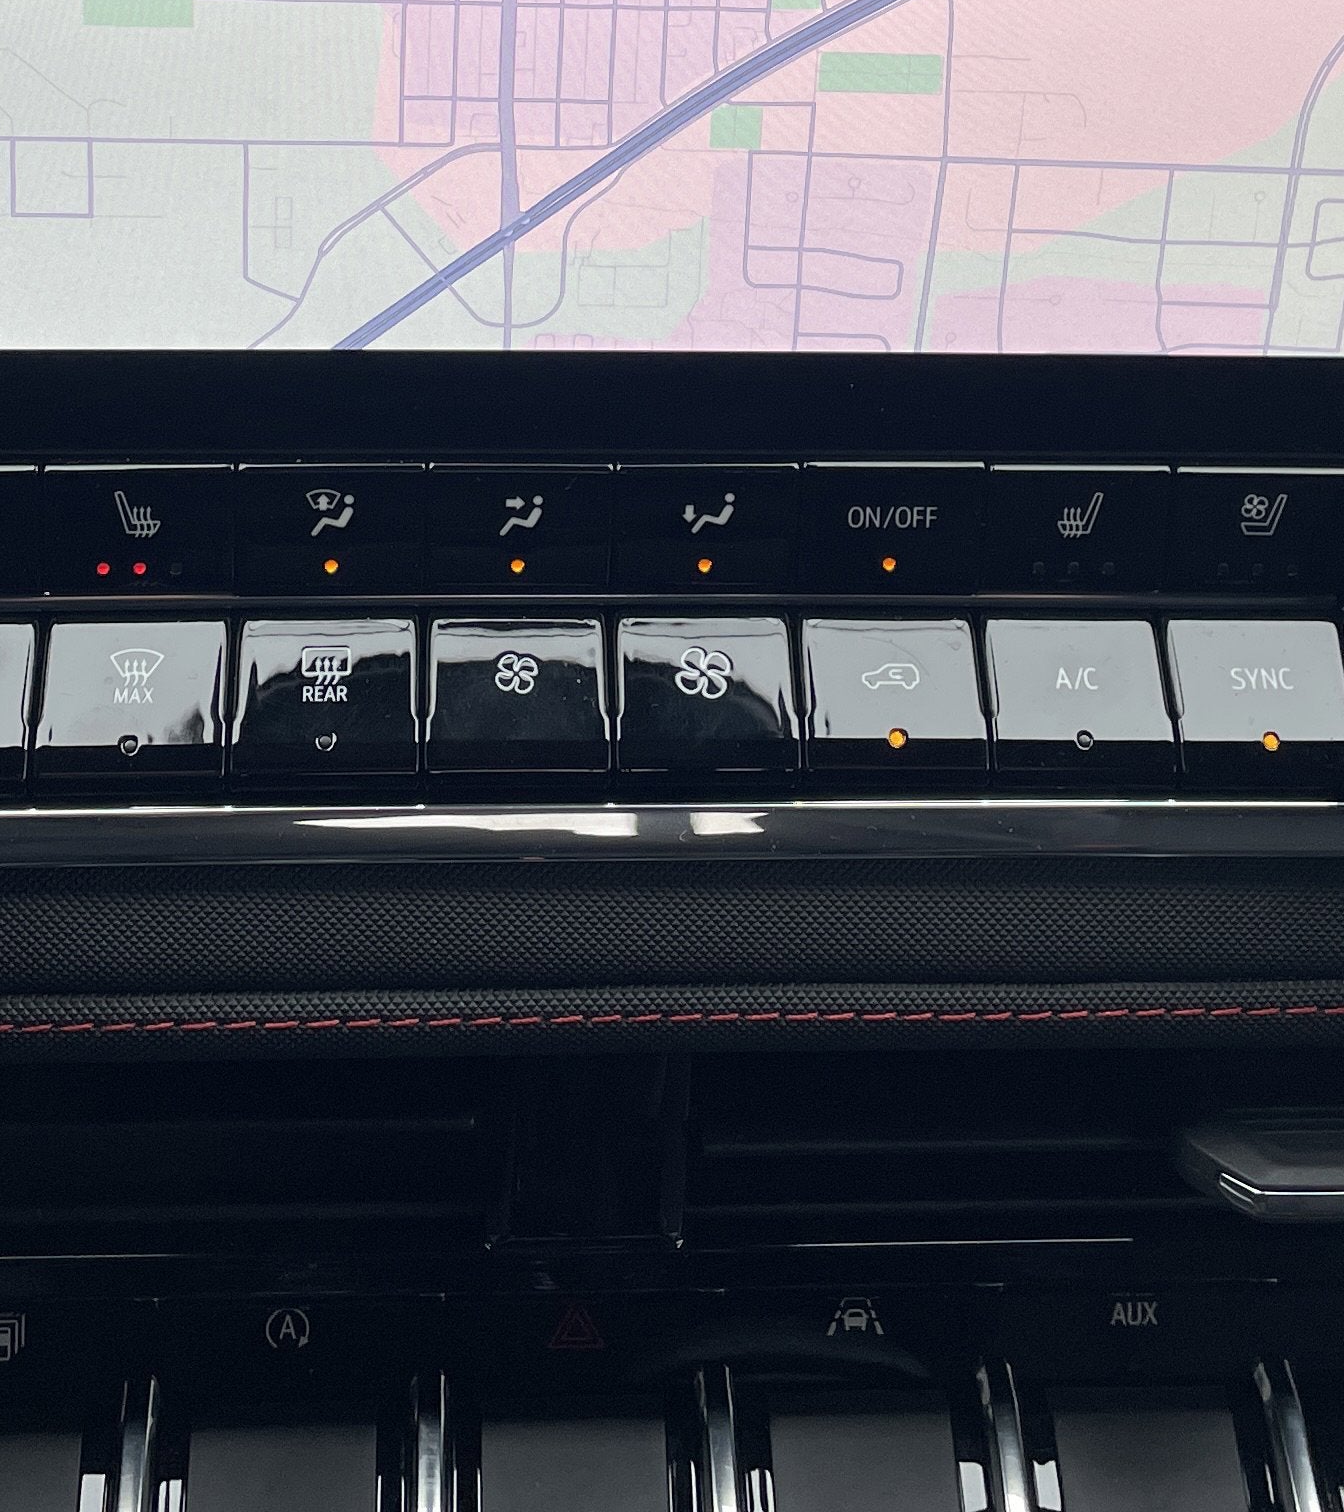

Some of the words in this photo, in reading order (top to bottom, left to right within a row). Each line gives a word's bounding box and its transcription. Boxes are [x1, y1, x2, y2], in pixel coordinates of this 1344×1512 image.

[847, 506, 938, 530] ON/OFF
[1056, 667, 1099, 691] A/C
[1230, 667, 1294, 691] SYNC
[113, 687, 154, 705] MAX
[301, 685, 348, 704] REAR
[1109, 1301, 1158, 1326] AUX
